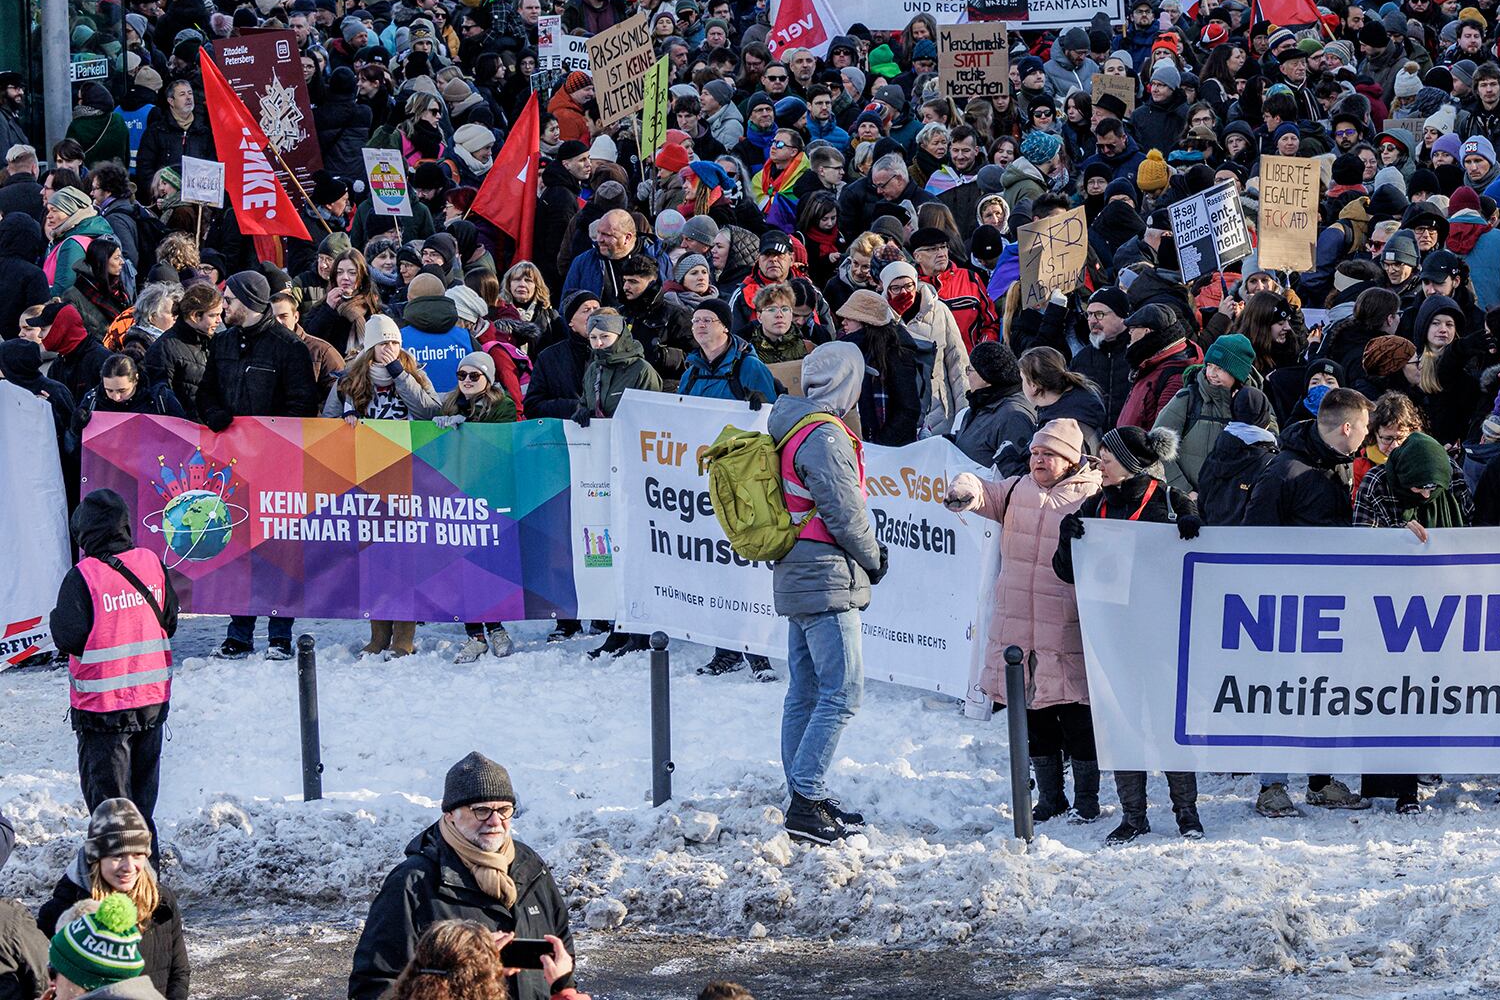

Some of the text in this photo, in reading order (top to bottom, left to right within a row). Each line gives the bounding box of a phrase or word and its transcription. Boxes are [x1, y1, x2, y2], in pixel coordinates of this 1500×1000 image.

[903, 1, 968, 14] UND RECH
[223, 45, 249, 57] Zitadelle
[591, 24, 650, 71] RASSISMUS
[941, 30, 1006, 51] Menschenrechte
[76, 63, 107, 78] Parken
[225, 54, 255, 66] Petersberg
[607, 49, 655, 86] IST KEINE
[954, 51, 994, 69] STATT
[956, 67, 986, 82] rechte
[946, 78, 1003, 98] Menschen
[1265, 163, 1311, 185] LIBERTÉ
[1206, 189, 1236, 208] Rassisten
[1264, 187, 1310, 209] EGALITÉ
[1173, 202, 1198, 221] #say
[1210, 206, 1235, 224] ent-
[1265, 210, 1308, 229] FCK AFD
[1175, 215, 1198, 234] their
[1177, 224, 1210, 247] names
[1213, 217, 1243, 241] waff-
[1216, 228, 1242, 254] nen!
[1042, 250, 1069, 275] IST
[641, 430, 688, 467] Für
[260, 491, 307, 516] KEIN
[316, 492, 382, 517] PLATZ
[388, 493, 422, 518] FÜR
[429, 495, 489, 521] NAZIS
[644, 476, 956, 556] Gege Rassisten
[259, 517, 500, 548] THEMAR BLEIBT BUNT!
[649, 526, 673, 556] in
[654, 585, 776, 618] THÜRINGER BÜNDNISSE,
[1220, 594, 1347, 652] NIE
[917, 635, 948, 651] RECHTS
[82, 934, 139, 961] RALLY
